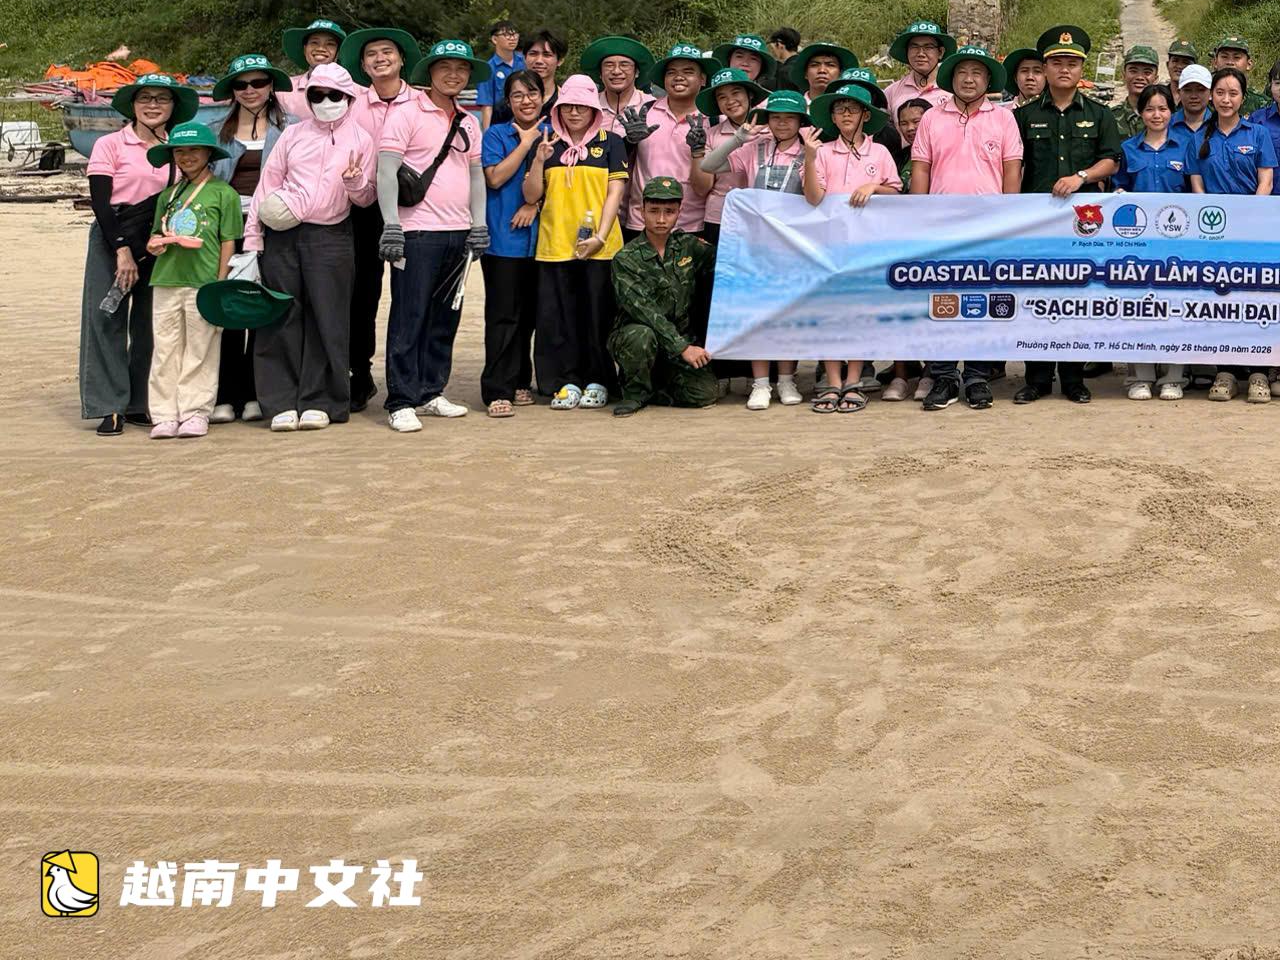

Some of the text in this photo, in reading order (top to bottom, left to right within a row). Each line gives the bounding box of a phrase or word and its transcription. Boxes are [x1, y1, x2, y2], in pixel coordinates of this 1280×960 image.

[1163, 224, 1182, 232] YSW
[894, 264, 991, 283] COASTAL
[995, 263, 1092, 281] CLEANUP
[1110, 259, 1150, 281] HÃY
[1154, 260, 1198, 283] LÀM
[1202, 265, 1256, 288] SẠCH
[1092, 296, 1118, 317] BỜ
[1123, 293, 1167, 318] BIỂN
[1185, 301, 1240, 320] XANH
[1245, 303, 1277, 325] ĐẠI
[1016, 341, 1048, 351] Phường
[1050, 341, 1071, 351] Rạch
[1094, 342, 1106, 350] TP.
[1121, 341, 1135, 350] Chí
[1181, 343, 1192, 352] 26
[1194, 344, 1217, 354] tháng
[1219, 345, 1230, 353] 09
[1250, 346, 1272, 354] 2026
